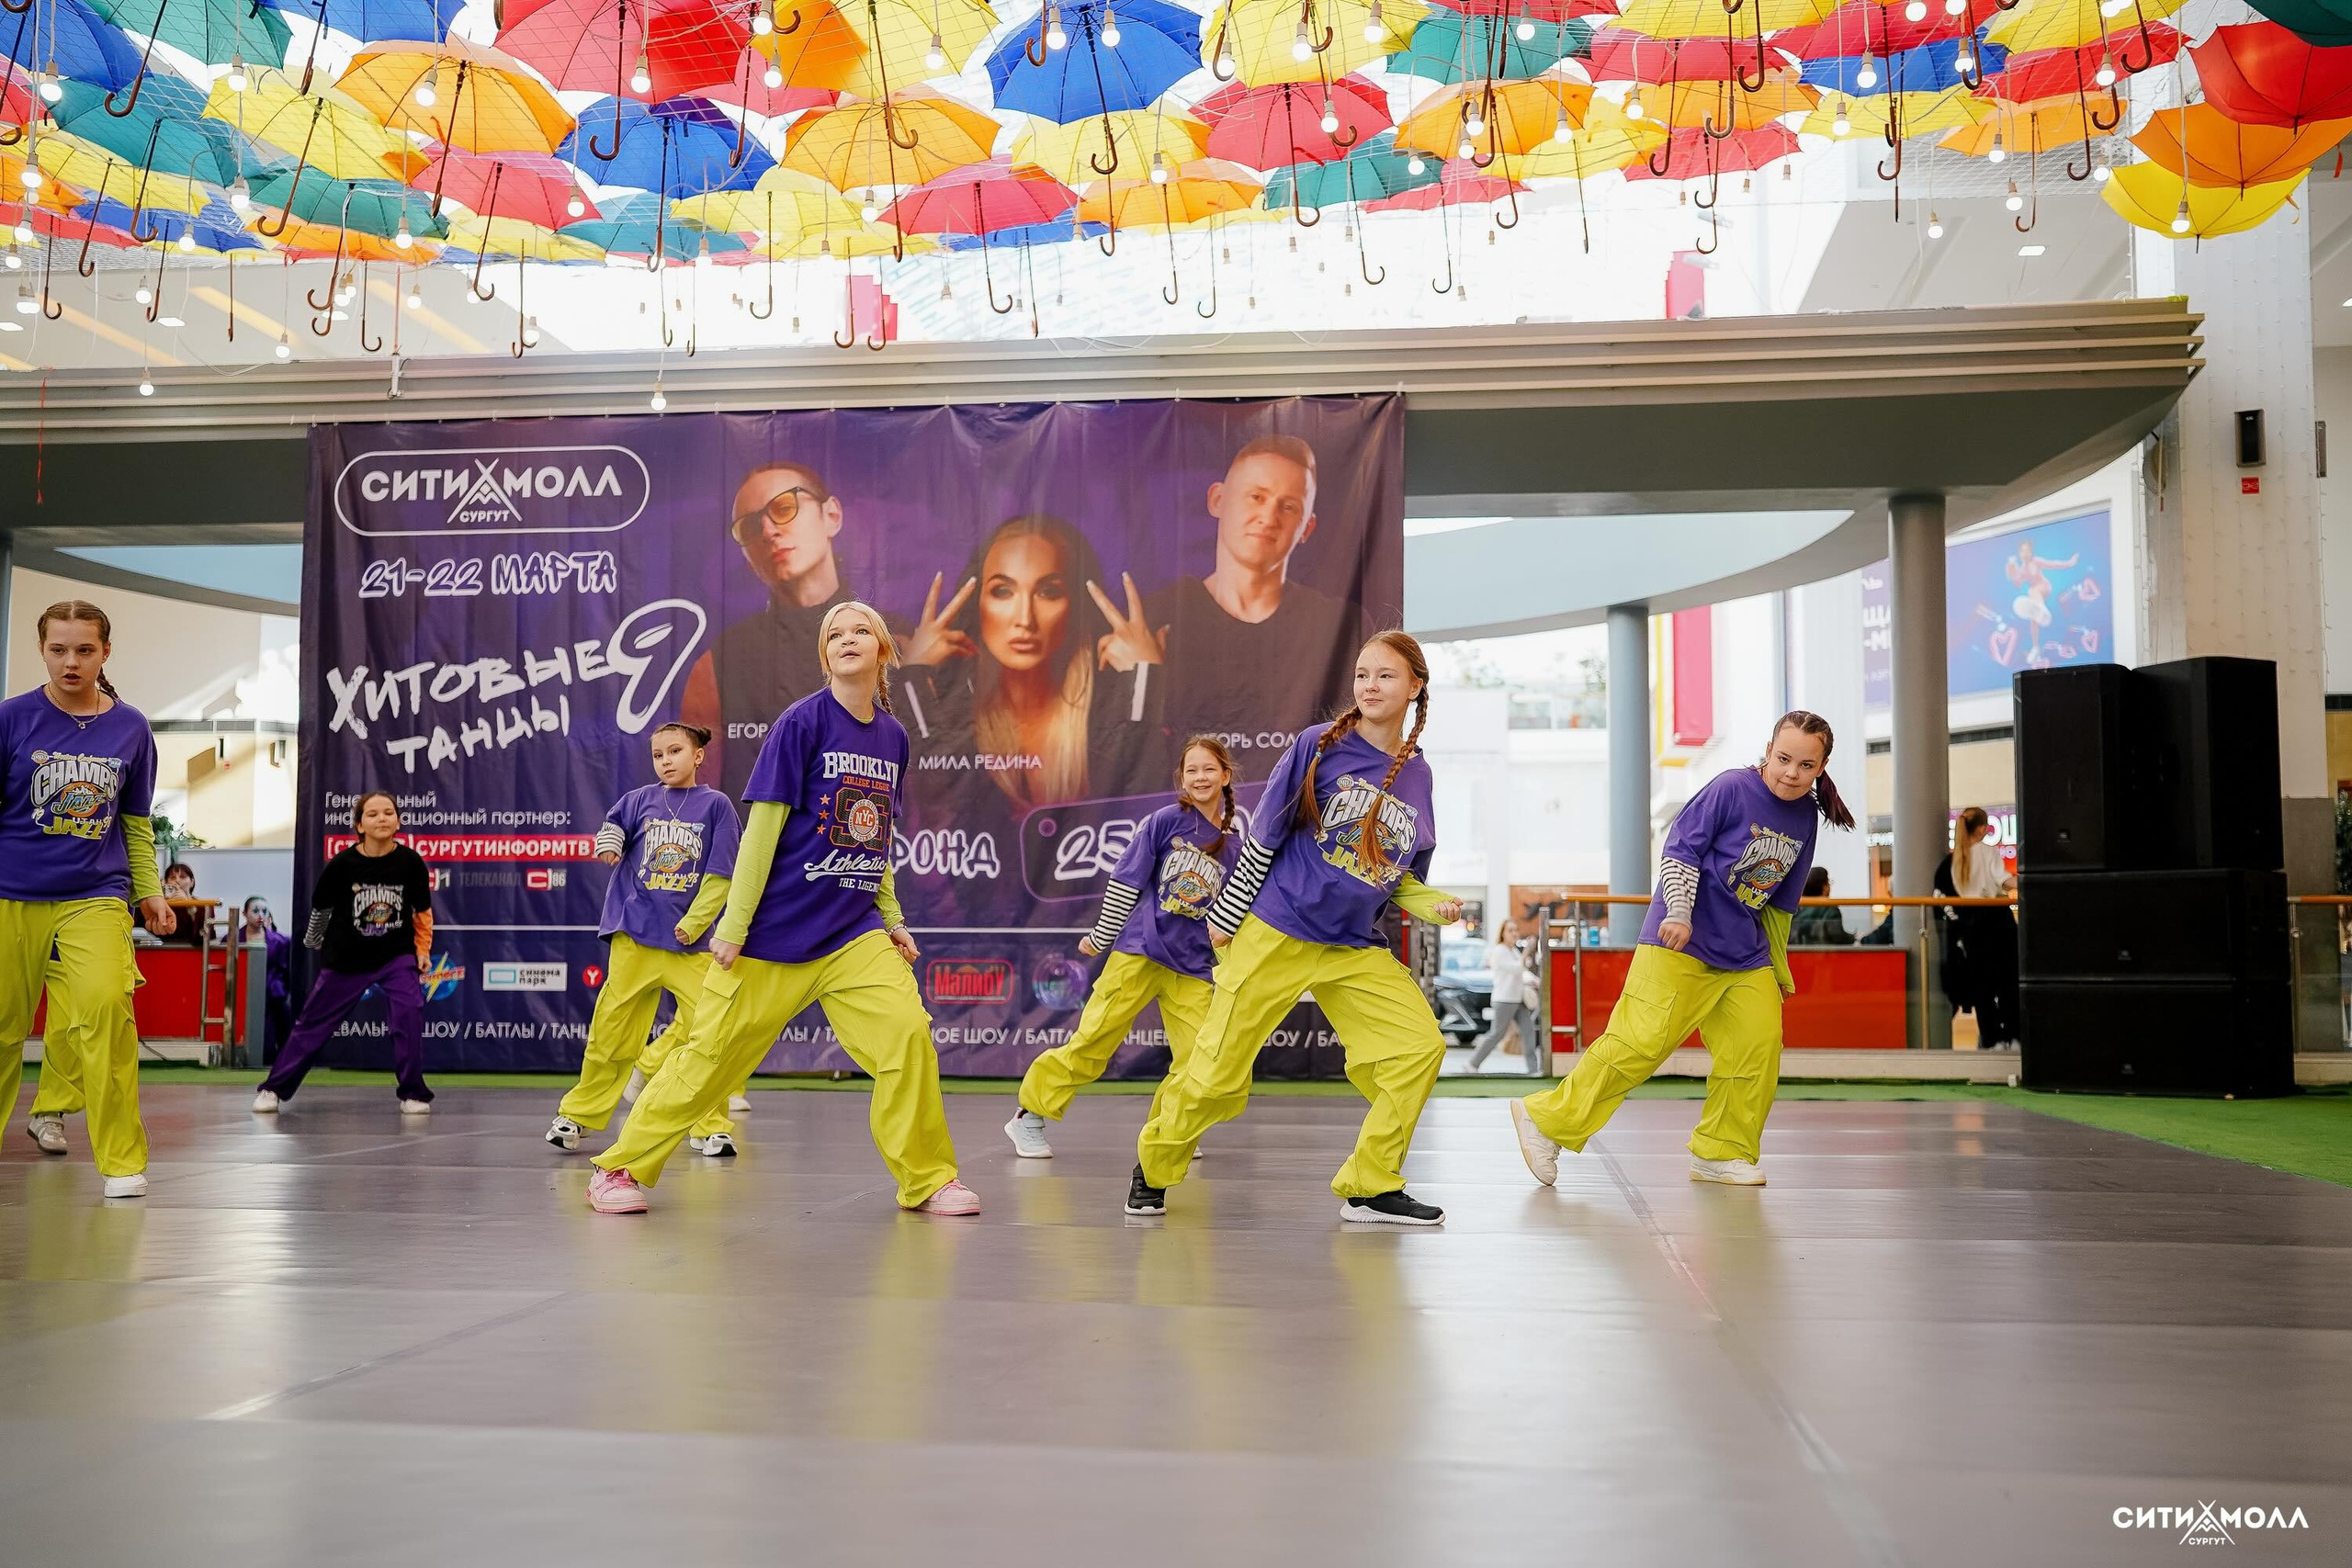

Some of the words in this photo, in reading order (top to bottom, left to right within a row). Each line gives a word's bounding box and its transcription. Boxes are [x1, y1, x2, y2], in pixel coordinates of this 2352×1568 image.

[459, 509, 510, 524] СУРГУТ
[358, 558, 484, 598] 21-22
[491, 550, 617, 595] МАРТА
[326, 639, 613, 739] ХИТОВЫЕ
[386, 694, 571, 774] ТАНЦЫ
[728, 722, 769, 739] ЕГОР
[1195, 731, 1253, 749] ОРЬ
[1255, 731, 1297, 749] СОЛ
[822, 751, 899, 790] BROOKLYN
[919, 755, 970, 770] МИЛА
[974, 754, 1043, 770] РЕДИНА
[31, 759, 119, 808] CHAMPS
[42, 816, 102, 840] JAZZ
[854, 809, 874, 827] NYC
[1321, 788, 1416, 854] CHAMPS
[640, 827, 703, 867] CHAMPS
[1731, 836, 1798, 873] CHAMP
[644, 873, 687, 893] JAZZ
[838, 877, 856, 889] THE
[354, 888, 402, 918] CHAMPS
[474, 1021, 535, 1039] БАТТЛЫ
[964, 1027, 1010, 1045] ШОУ
